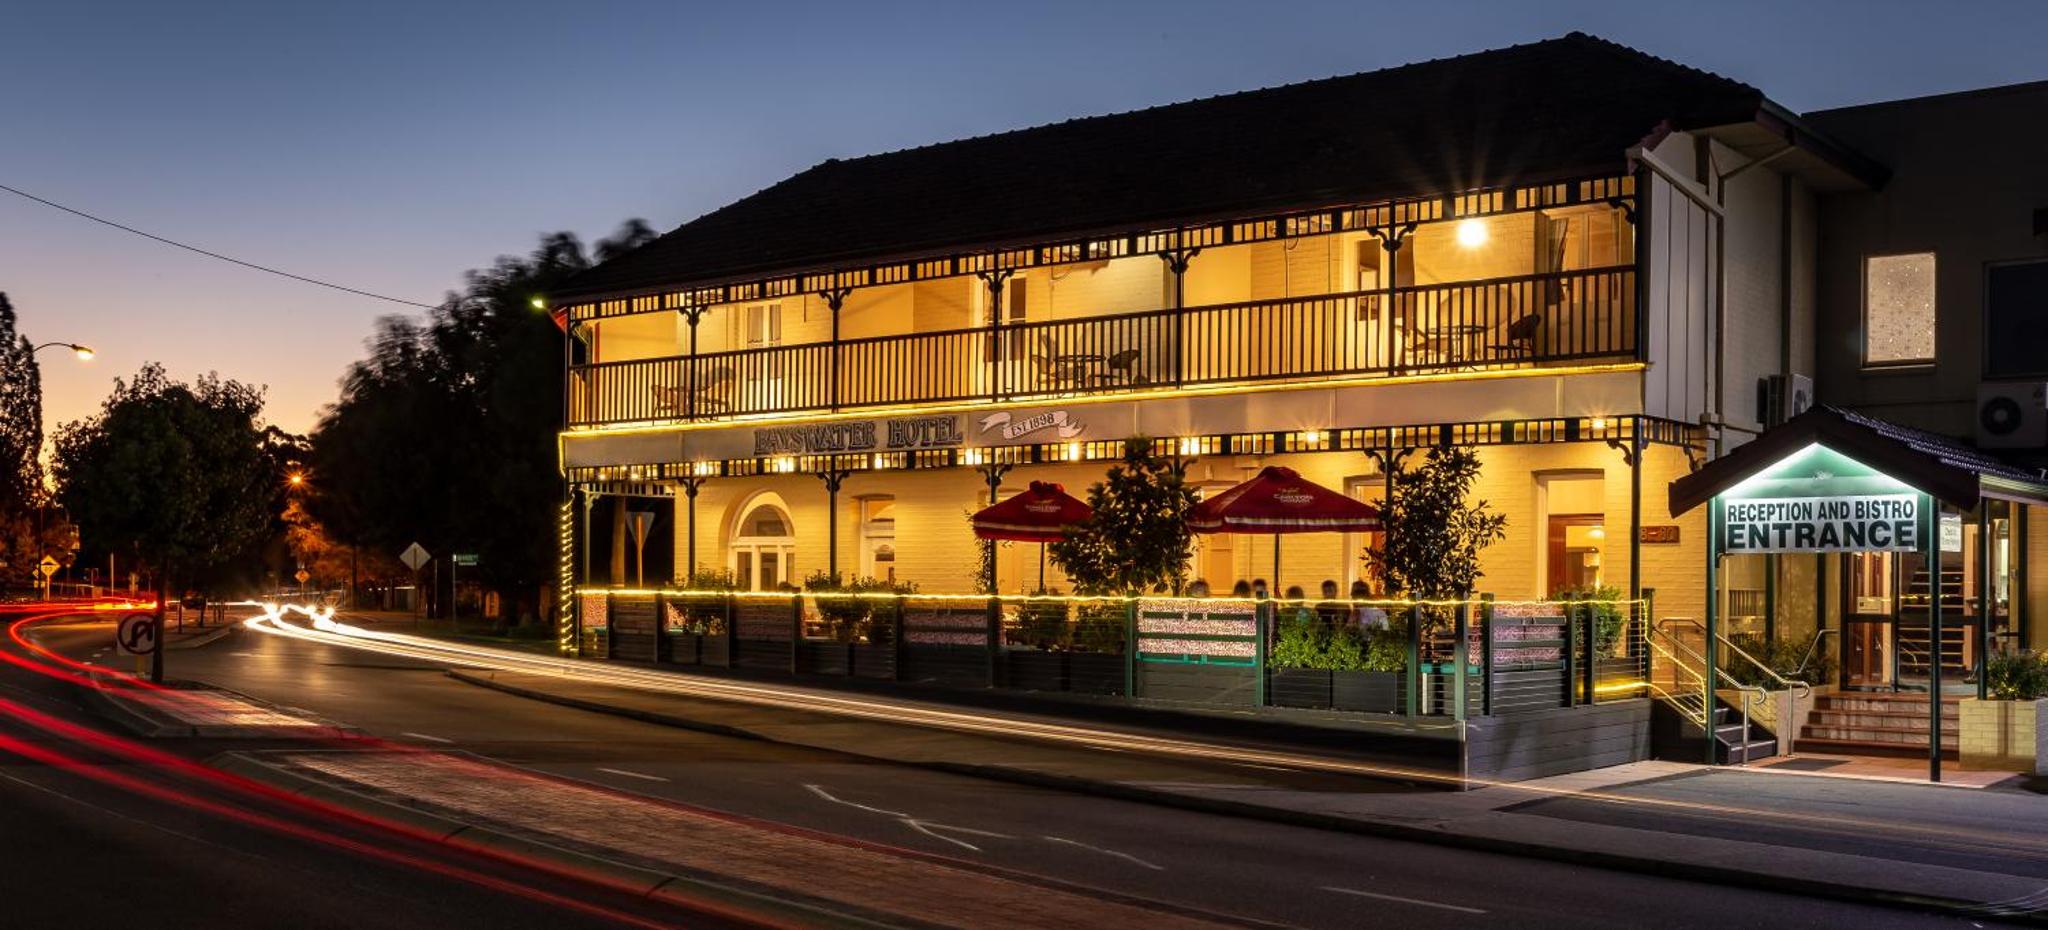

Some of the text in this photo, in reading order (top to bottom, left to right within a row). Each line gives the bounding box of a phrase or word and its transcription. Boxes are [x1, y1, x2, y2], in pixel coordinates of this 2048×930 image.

[1028, 413, 1055, 430] 1898
[754, 415, 963, 456] BAYSWATER HOTEL
[1728, 500, 1914, 522] RECEPTION AND BISTRO
[1728, 520, 1914, 548] ENTRANCE
